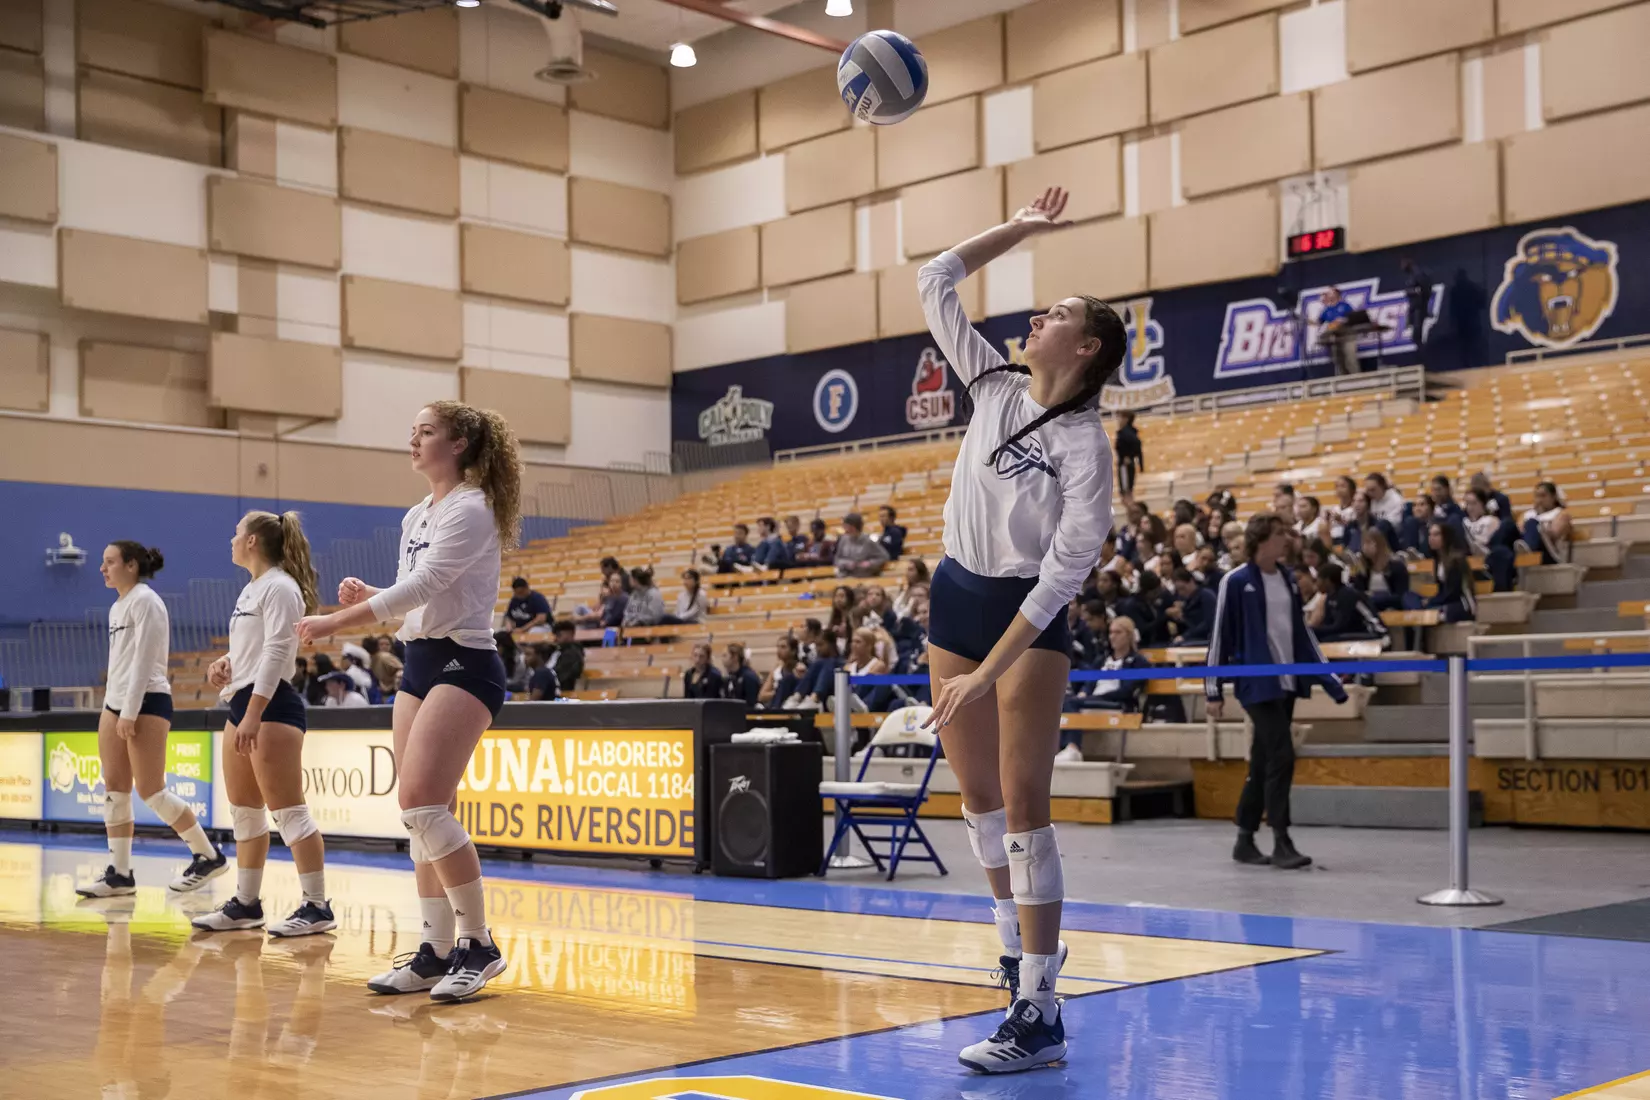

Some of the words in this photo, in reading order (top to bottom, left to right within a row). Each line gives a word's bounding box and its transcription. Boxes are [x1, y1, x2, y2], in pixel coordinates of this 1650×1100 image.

[829, 384, 845, 419] F
[908, 396, 952, 421] CSUN
[176, 743, 201, 757] PRINT
[578, 740, 685, 768] LABORERS
[176, 762, 201, 777] SIGNS
[456, 738, 575, 796] UNA!
[1497, 767, 1600, 792] SECTION
[1611, 768, 1649, 791] 101
[176, 782, 196, 798] WEB
[578, 771, 642, 798] LOCAL
[648, 773, 694, 800] 1184
[537, 804, 694, 848] RIVERSIDE
